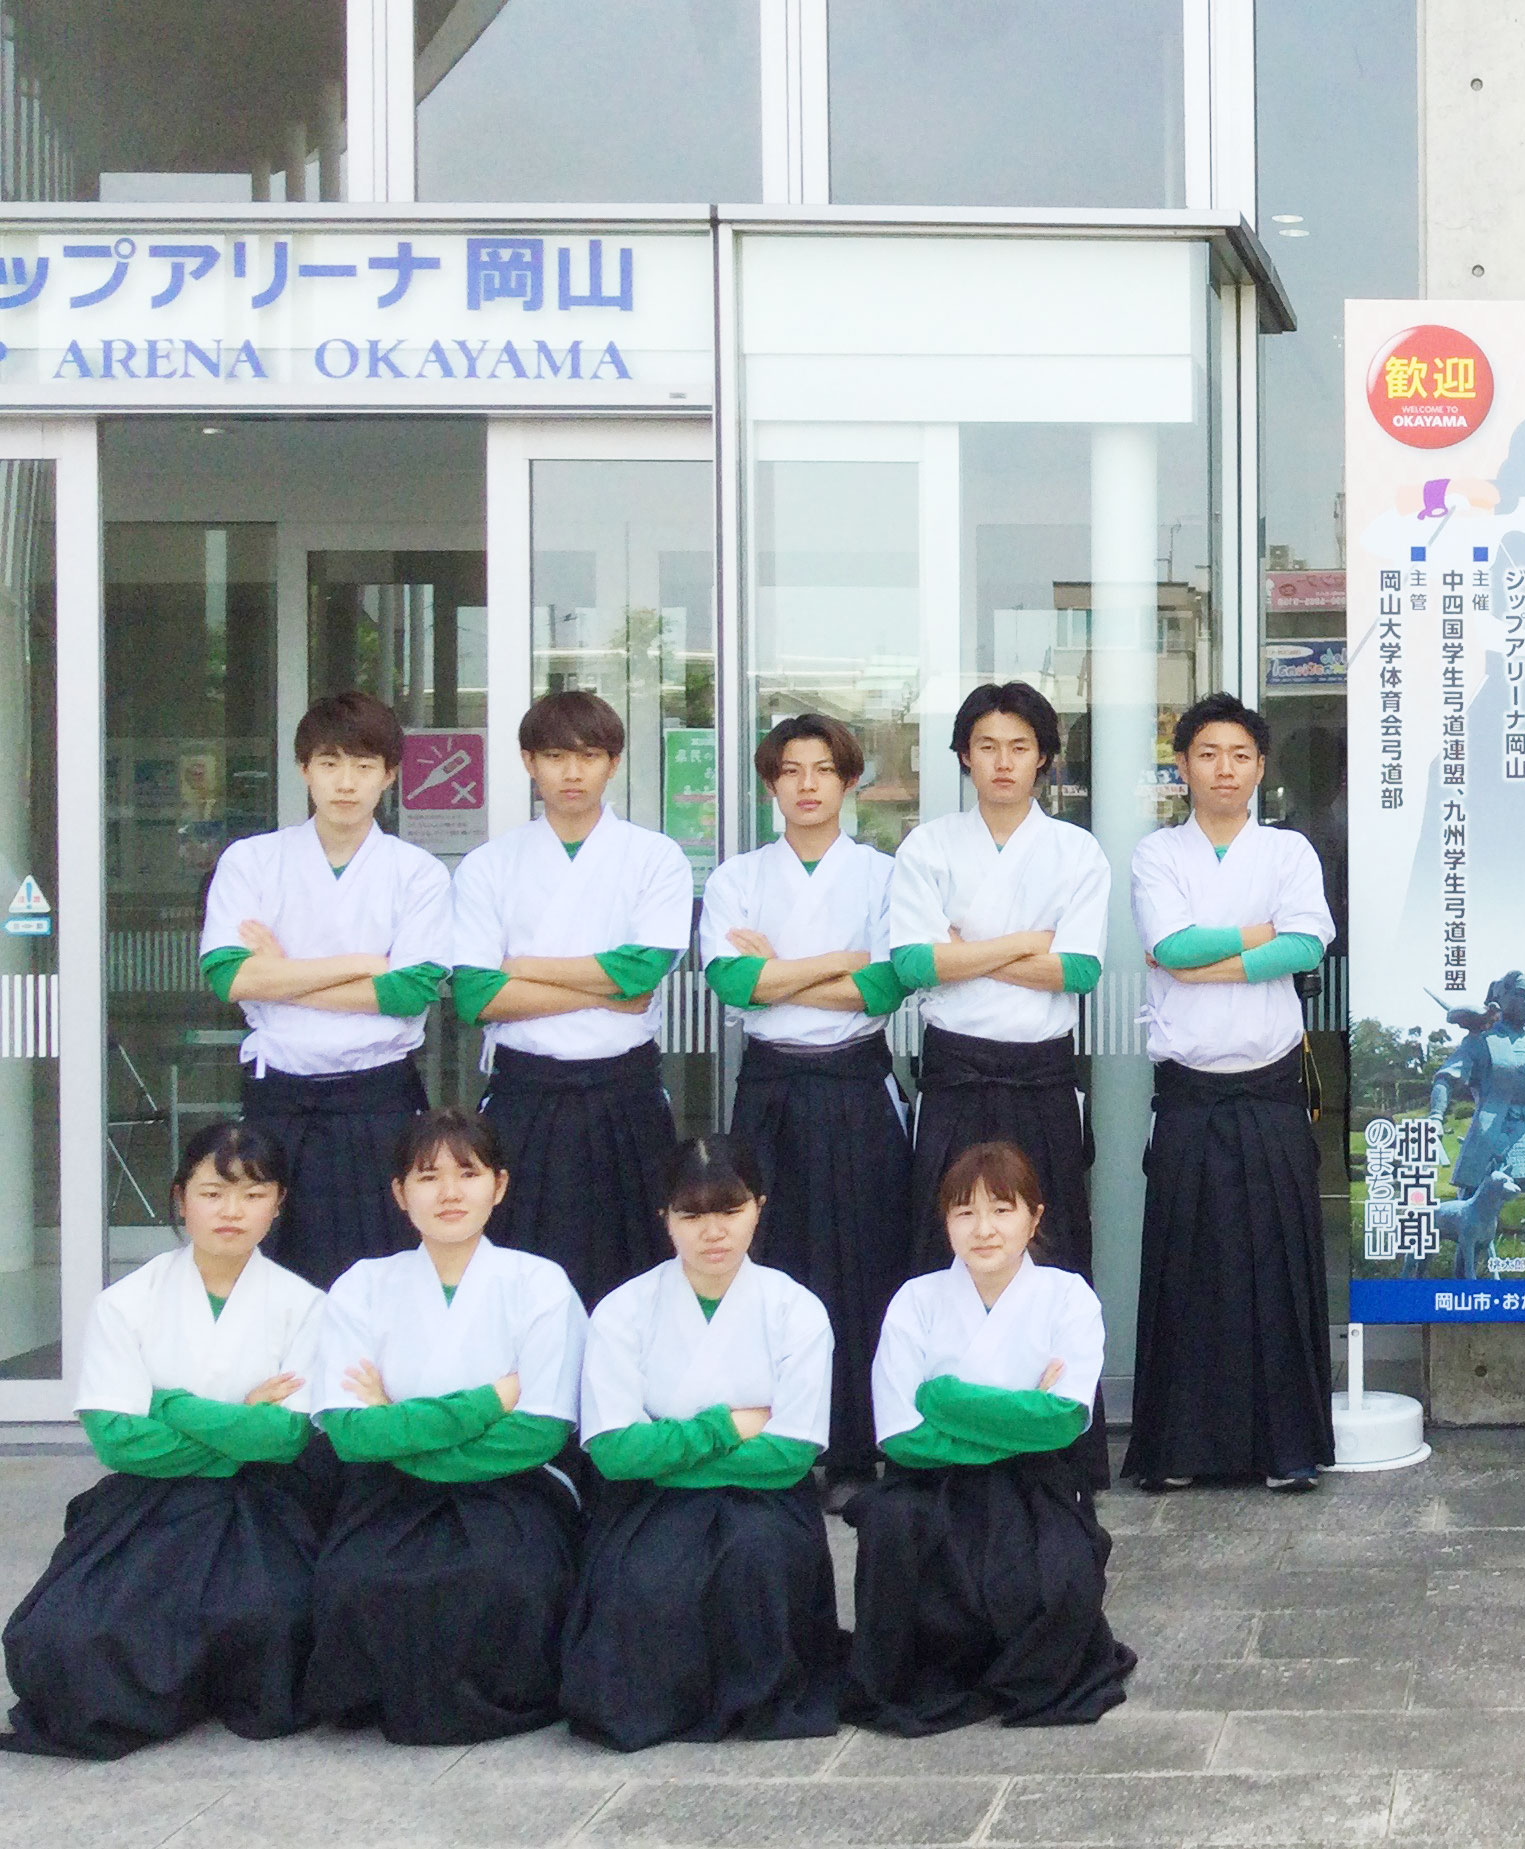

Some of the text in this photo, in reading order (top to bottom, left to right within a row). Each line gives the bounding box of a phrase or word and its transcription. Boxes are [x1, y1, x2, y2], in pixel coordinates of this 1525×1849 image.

[53, 339, 268, 379] ARENA
[314, 338, 633, 379] OKAYAMA
[1385, 356, 1476, 399] 歓迎
[1392, 415, 1468, 428] OKAYAMA
[1401, 405, 1458, 414] WELCOME TO
[1409, 569, 1428, 613] 主管
[1471, 569, 1491, 613] 主催
[1378, 569, 1404, 810] 岡山大学体育会弓道部
[1441, 569, 1467, 992] 中四国学生弓道連盟、九州学生弓道連盟
[1365, 1119, 1397, 1259] のまち岡山
[1398, 1120, 1439, 1259] 桃太郎
